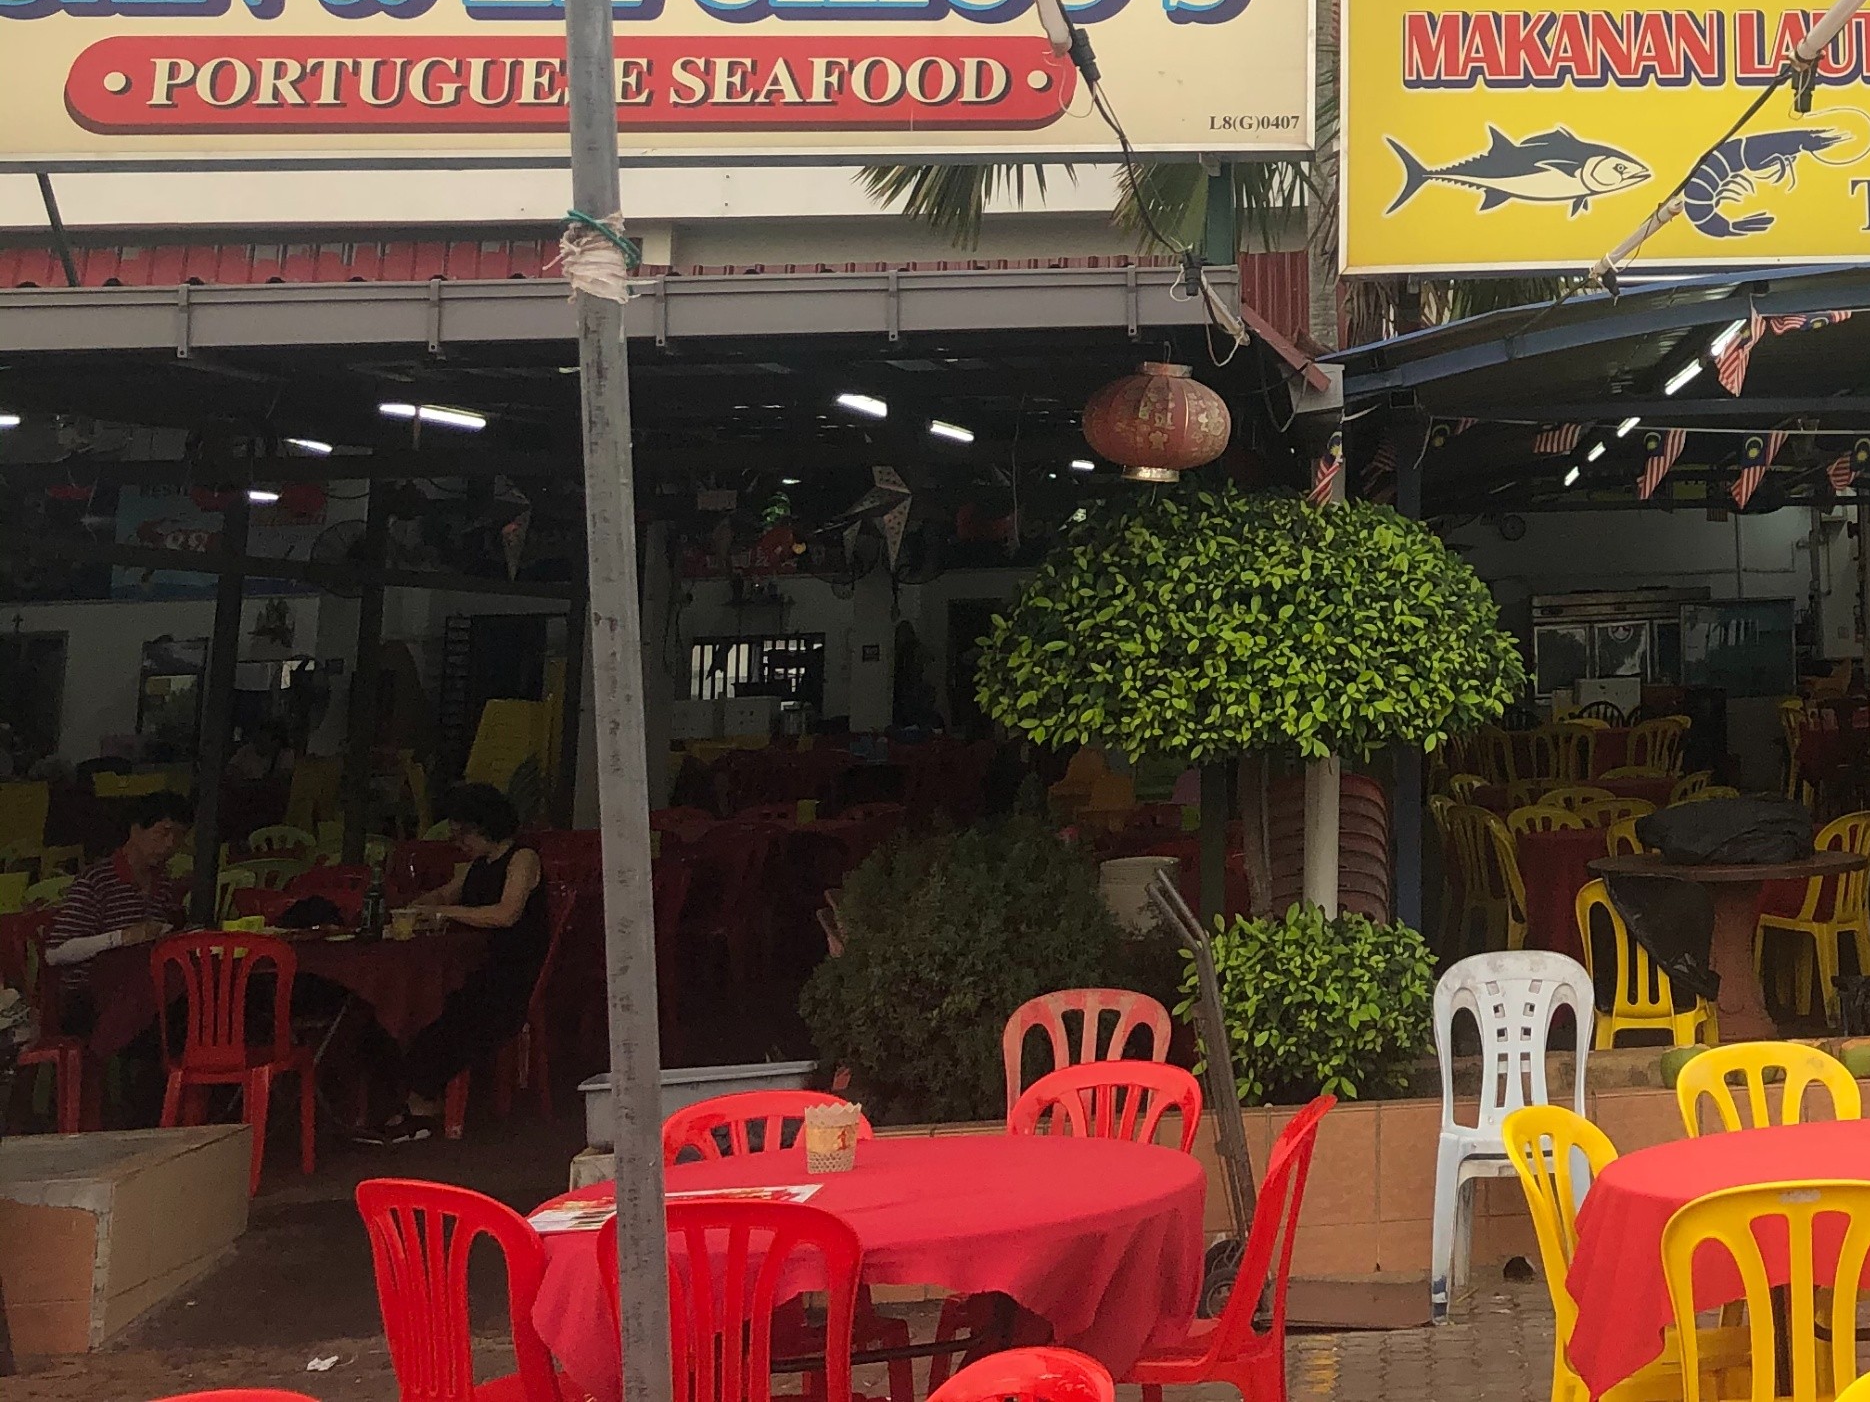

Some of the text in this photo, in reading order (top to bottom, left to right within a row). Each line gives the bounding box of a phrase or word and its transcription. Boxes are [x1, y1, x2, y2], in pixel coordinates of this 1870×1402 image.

[1401, 8, 1727, 90] MAKANAN
[146, 55, 1012, 110] PORTUGUEE SEAFOOD
[1209, 114, 1300, 132] L8(G)0407
